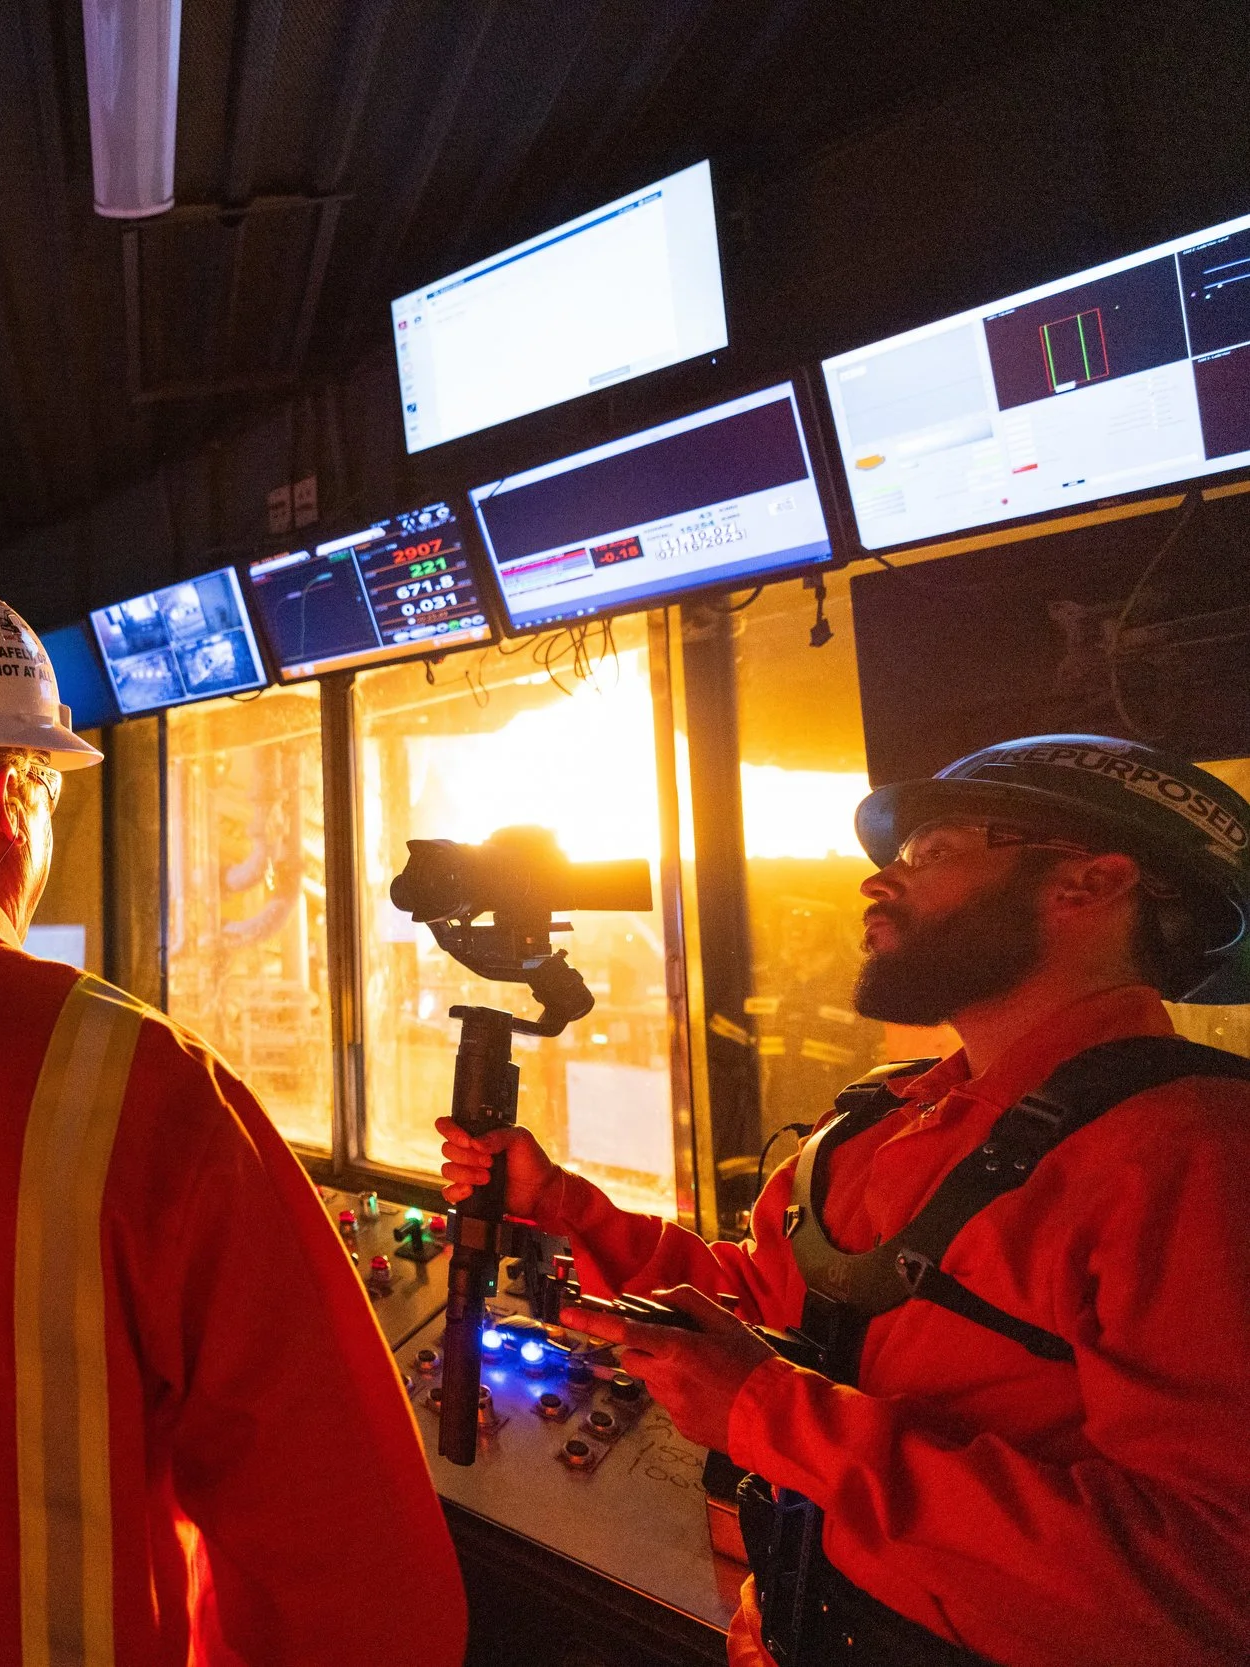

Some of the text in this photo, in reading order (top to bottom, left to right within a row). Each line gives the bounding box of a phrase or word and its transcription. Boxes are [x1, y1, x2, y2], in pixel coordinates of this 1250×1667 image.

[392, 538, 443, 564] 2907
[409, 557, 447, 578] 221
[396, 575, 454, 599] 671.8
[401, 593, 457, 616] 0.031
[24, 665, 36, 678] AT
